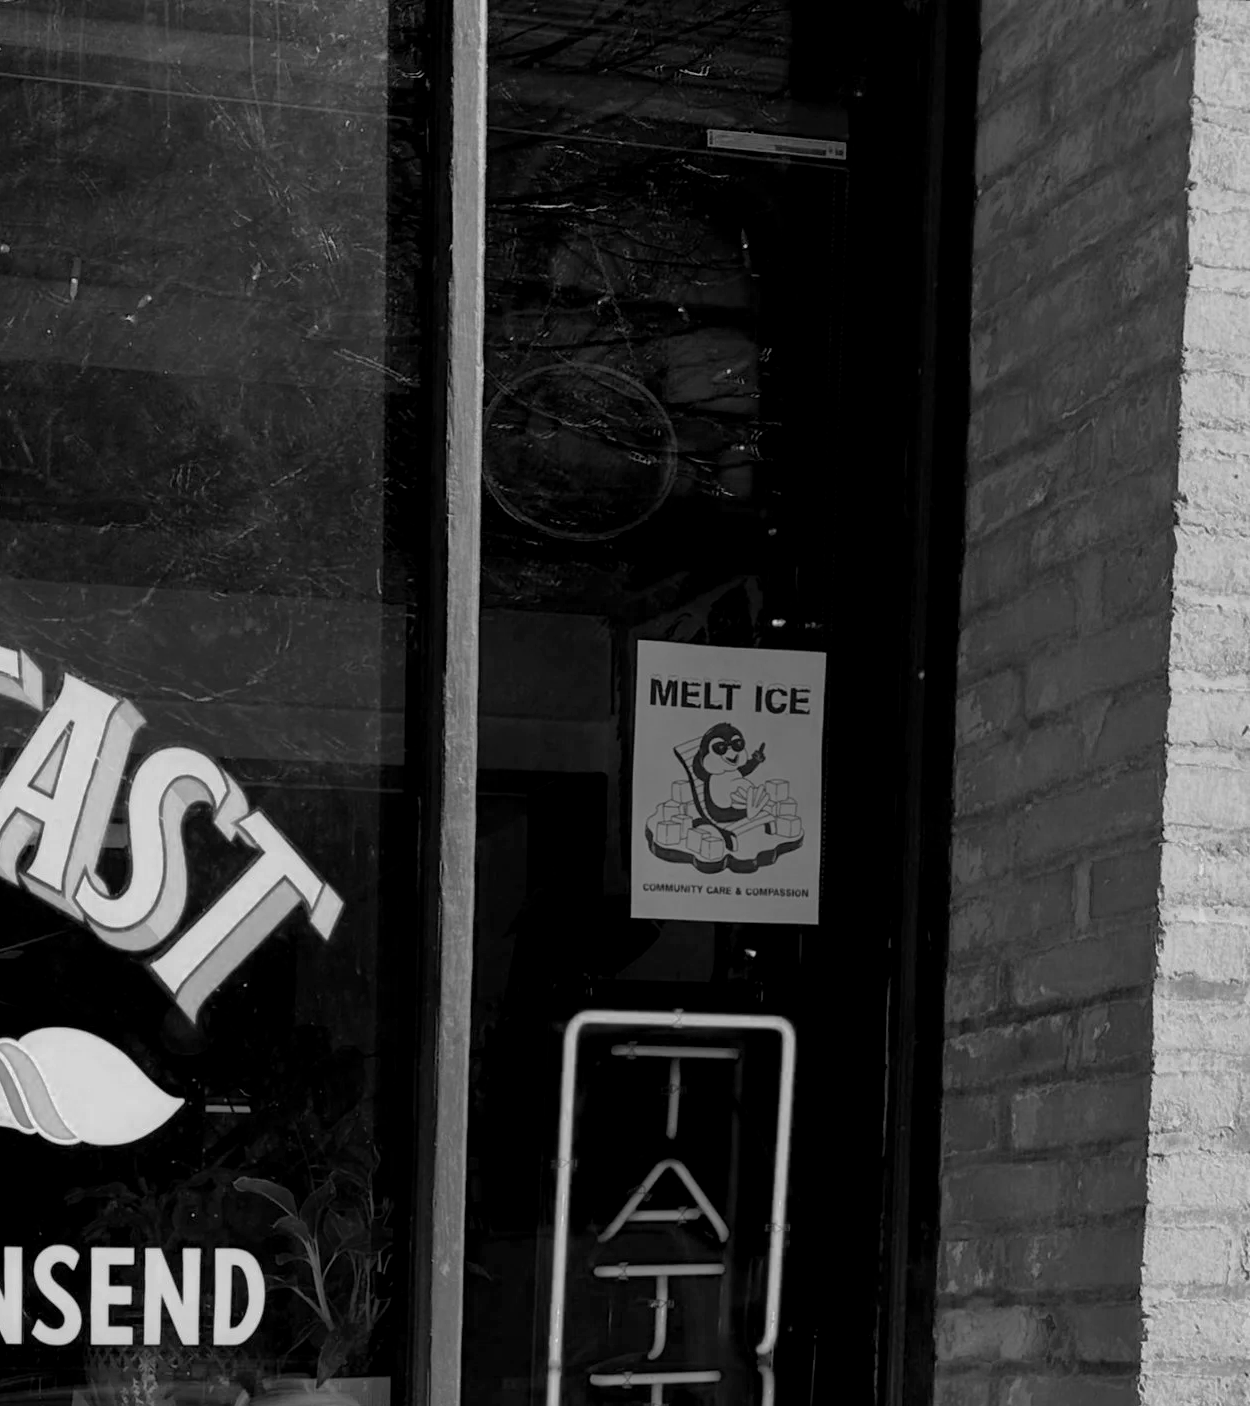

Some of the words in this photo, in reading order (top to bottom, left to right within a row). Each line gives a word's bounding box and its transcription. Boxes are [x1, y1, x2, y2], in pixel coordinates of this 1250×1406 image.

[649, 674, 741, 711] MELT
[755, 682, 812, 716] ICE
[642, 883, 703, 895] COMMUNITY
[706, 885, 732, 896] CARE
[735, 887, 742, 896] &
[745, 887, 810, 898] COMPASSION
